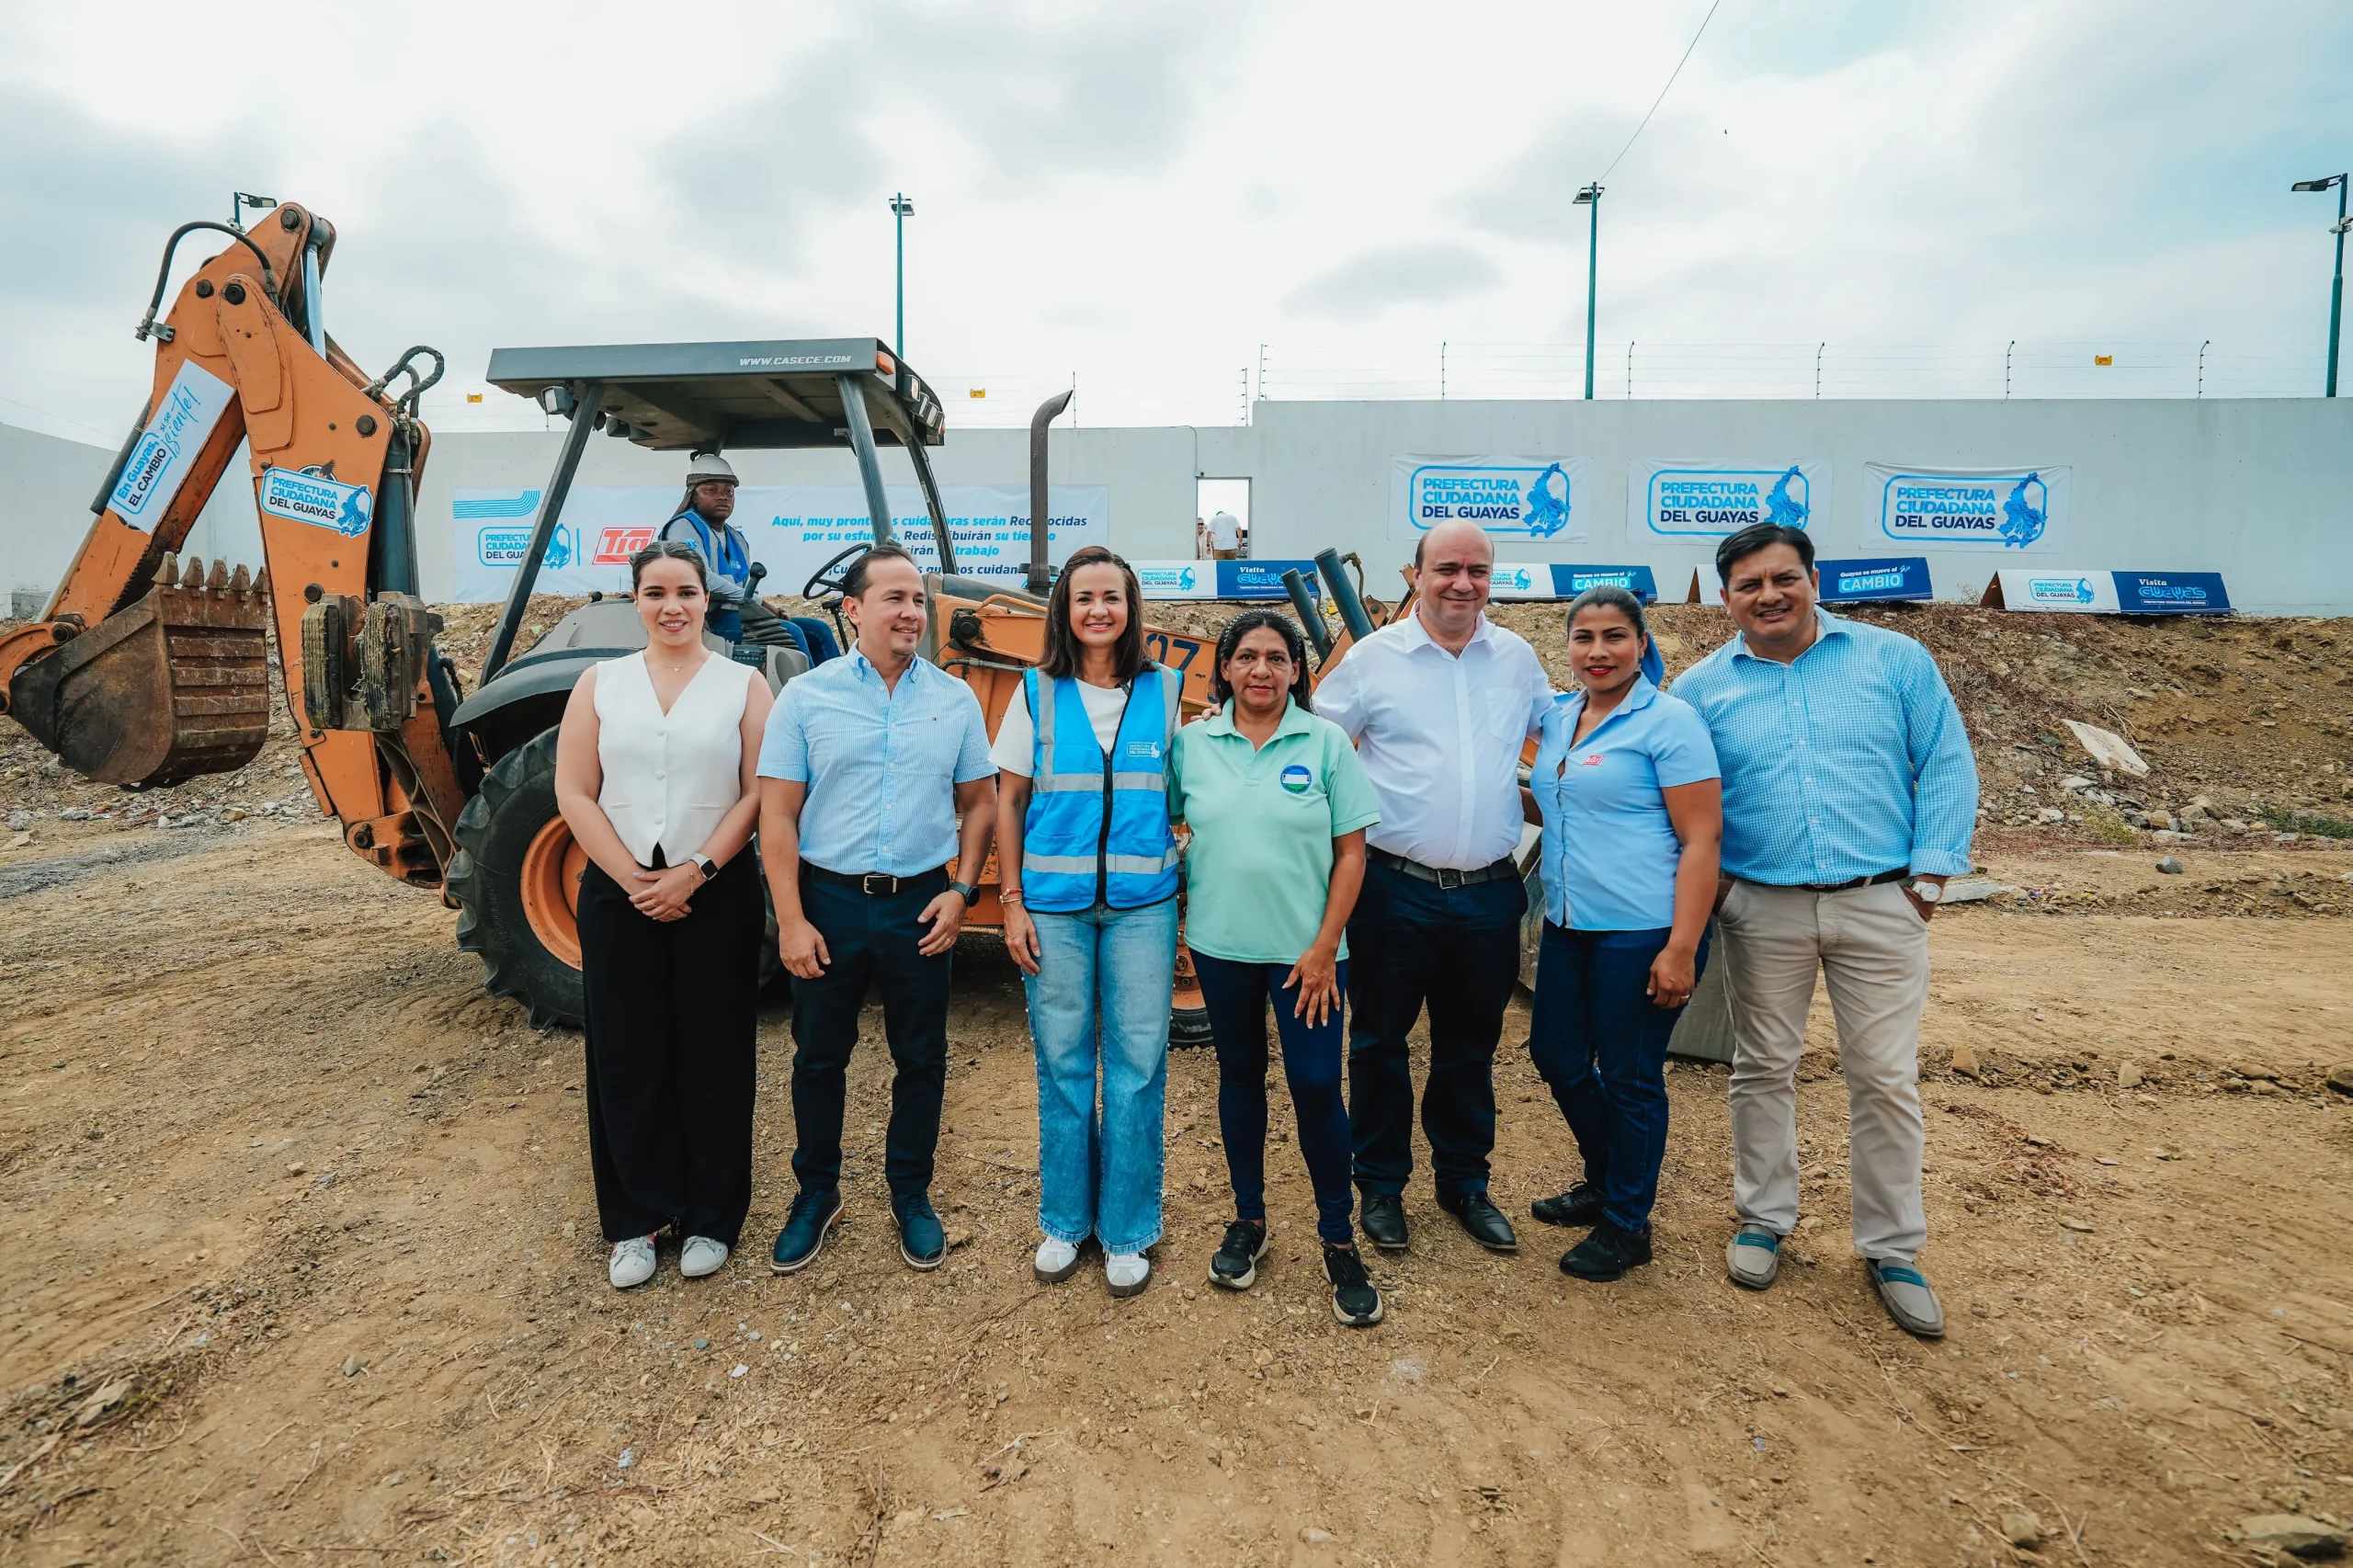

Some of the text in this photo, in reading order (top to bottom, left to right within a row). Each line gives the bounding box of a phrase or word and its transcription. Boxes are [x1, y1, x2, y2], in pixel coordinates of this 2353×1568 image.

[739, 355, 852, 366] WWW.CASECE.COM
[164, 411, 172, 423] se
[117, 440, 160, 500] En Guayas,
[128, 448, 167, 507] EL CAMBIO
[1423, 477, 1521, 492] PREFECTURA
[272, 476, 338, 501] PREFECTURA
[1661, 482, 1759, 495] PREFECTURA
[1896, 486, 1996, 502] PREFECTURA
[270, 486, 336, 510] CIUDADANA
[1422, 492, 1520, 506] CIUDADANA
[1660, 495, 1759, 509] CIUDADANA
[269, 496, 336, 520] DEL GUAYAS
[1422, 506, 1520, 520] DEL GUAYAS
[1895, 500, 1996, 516] CIUDADANA
[771, 516, 804, 528] Aquí,
[807, 517, 834, 528] muy
[835, 517, 871, 528] pront
[972, 515, 1006, 526] serán
[1660, 510, 1759, 524] DEL GUAYAS
[1894, 515, 1996, 530] DEL GUAYAS
[485, 534, 531, 542] PREFECTU
[802, 533, 824, 542] por
[826, 533, 842, 541] su
[995, 532, 1009, 541] su
[485, 541, 529, 551] CIUDADA
[954, 546, 1000, 556] trabajo
[485, 551, 505, 560] DEL
[1574, 577, 1629, 589] CAMBIO
[1841, 574, 1901, 592] CAMBIO
[2139, 578, 2167, 586] Visita
